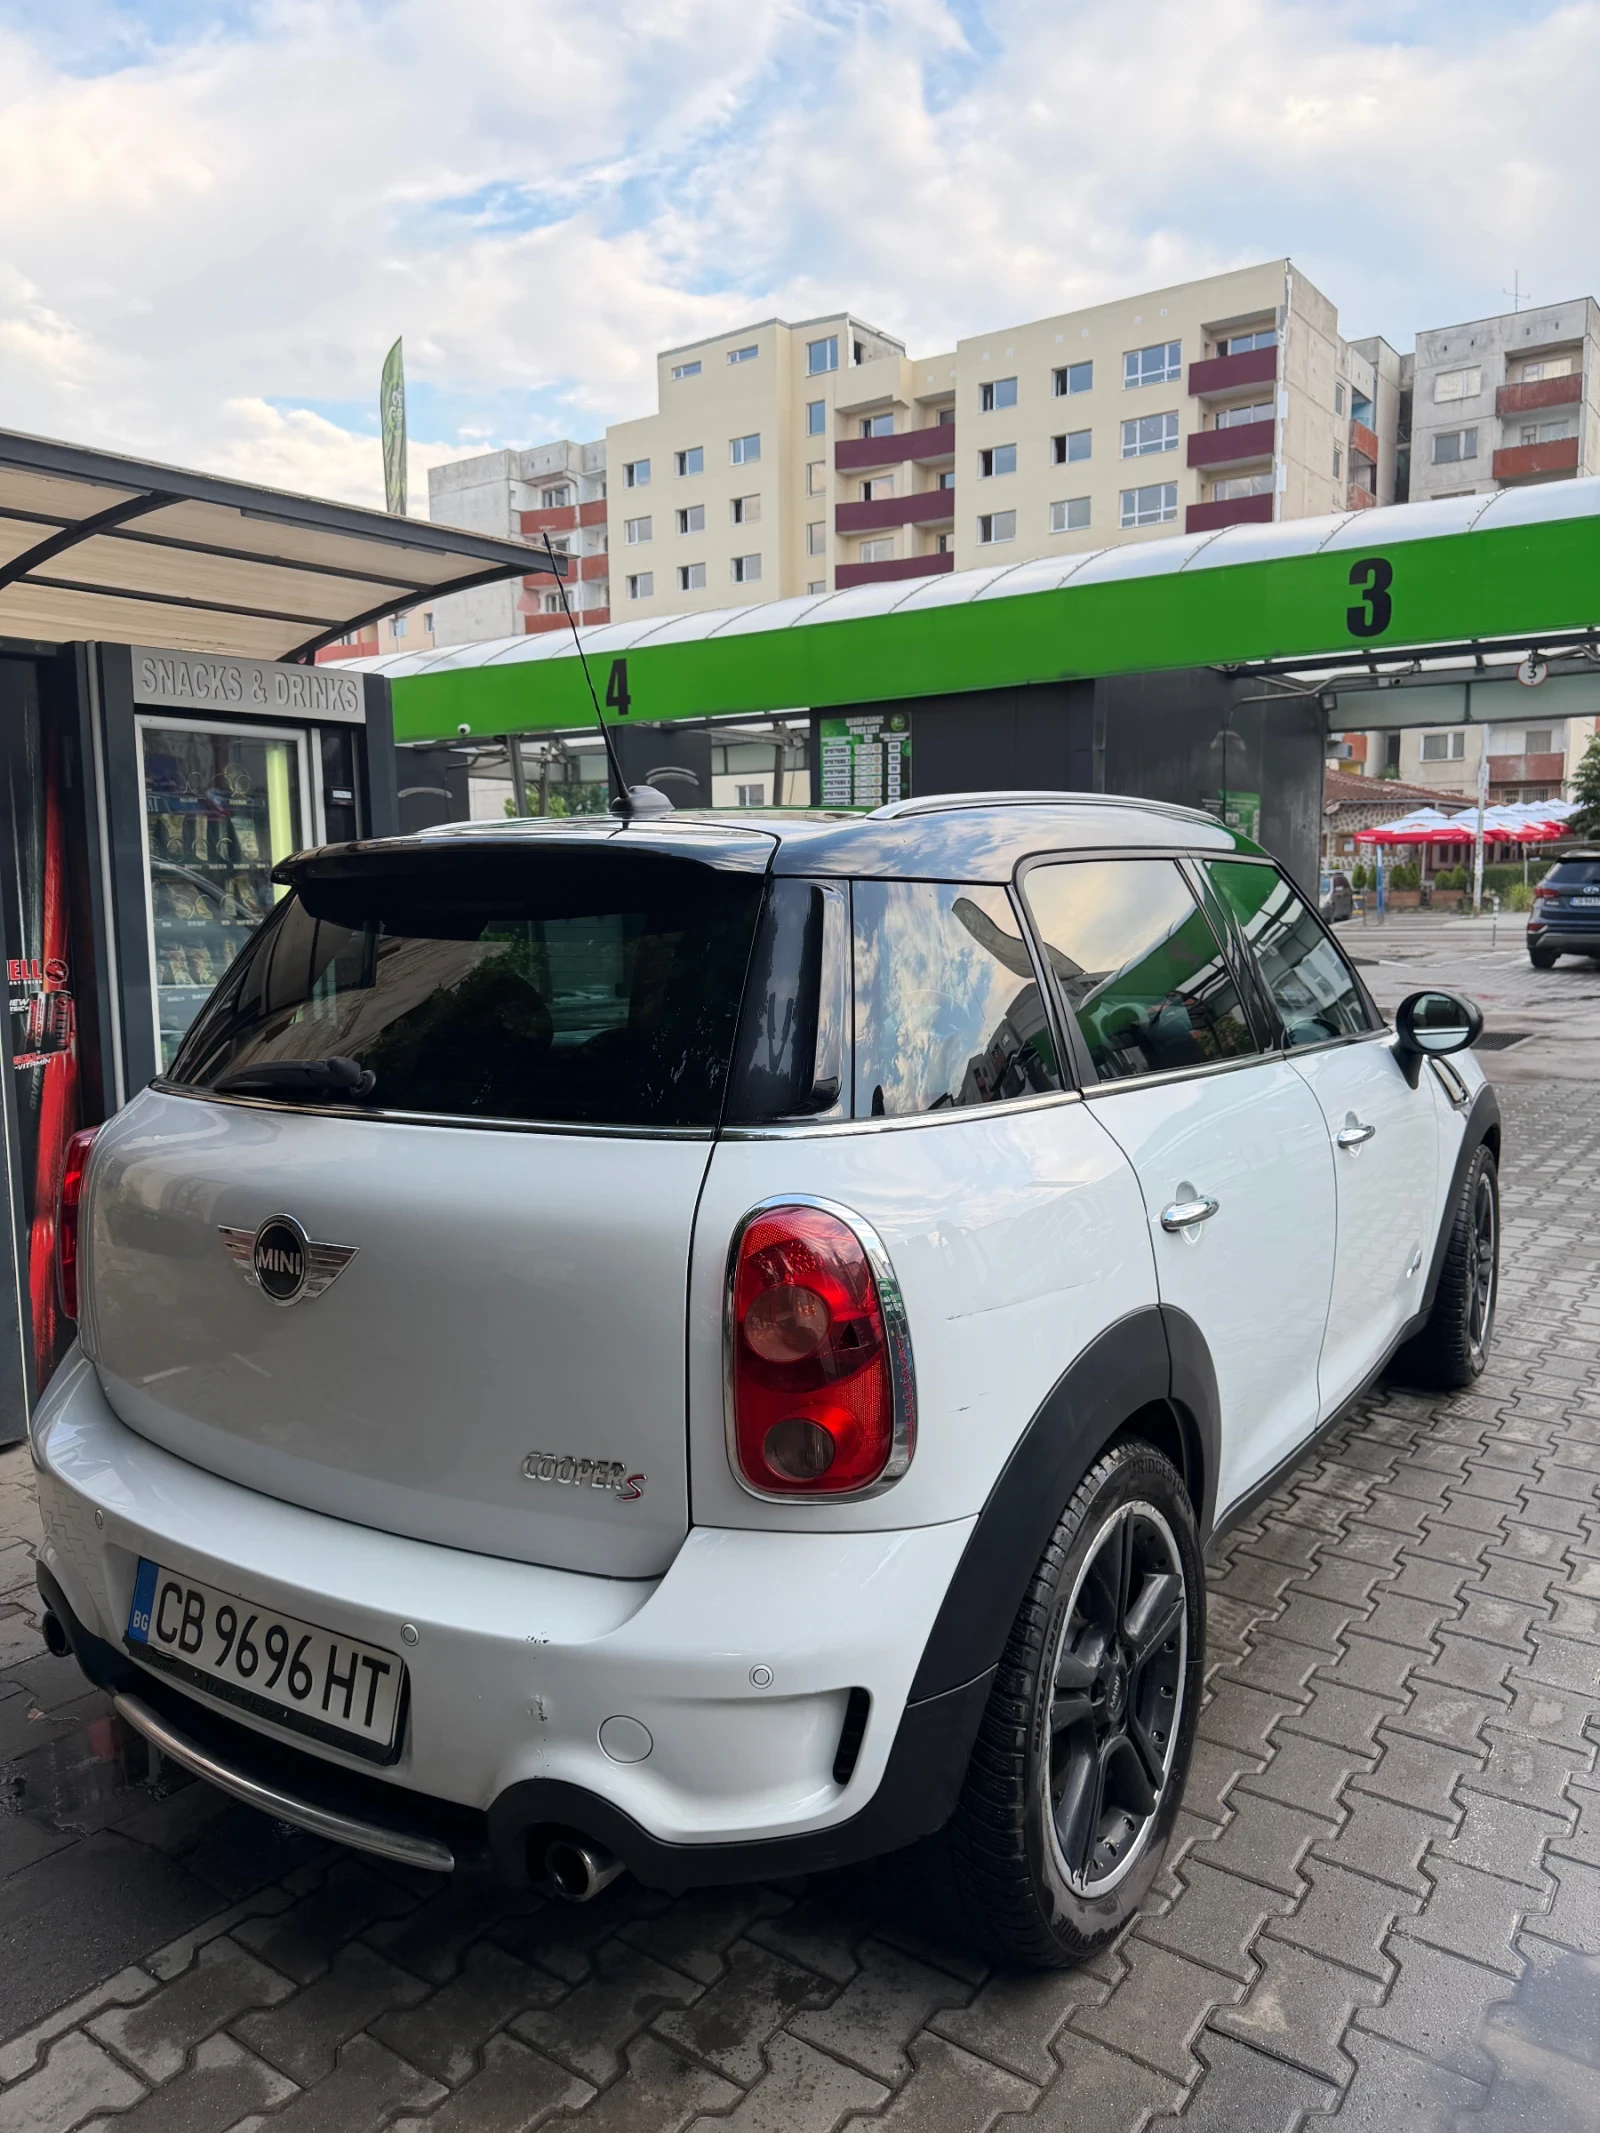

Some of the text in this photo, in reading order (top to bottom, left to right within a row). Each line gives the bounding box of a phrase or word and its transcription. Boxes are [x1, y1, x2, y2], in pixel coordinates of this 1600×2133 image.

[1347, 557, 1393, 637] 3
[141, 657, 359, 713] SNACKS & DRINKS
[606, 658, 632, 716] 4
[1527, 662, 1537, 679] 3
[7, 959, 42, 981] ELL
[258, 1246, 302, 1276] MINI
[522, 1451, 647, 1502] COOPER S
[132, 1610, 149, 1632] BG
[156, 1581, 206, 1654] CB
[214, 1605, 314, 1700] 9696
[322, 1645, 391, 1727] HT
[1108, 1675, 1121, 1709] MINI
